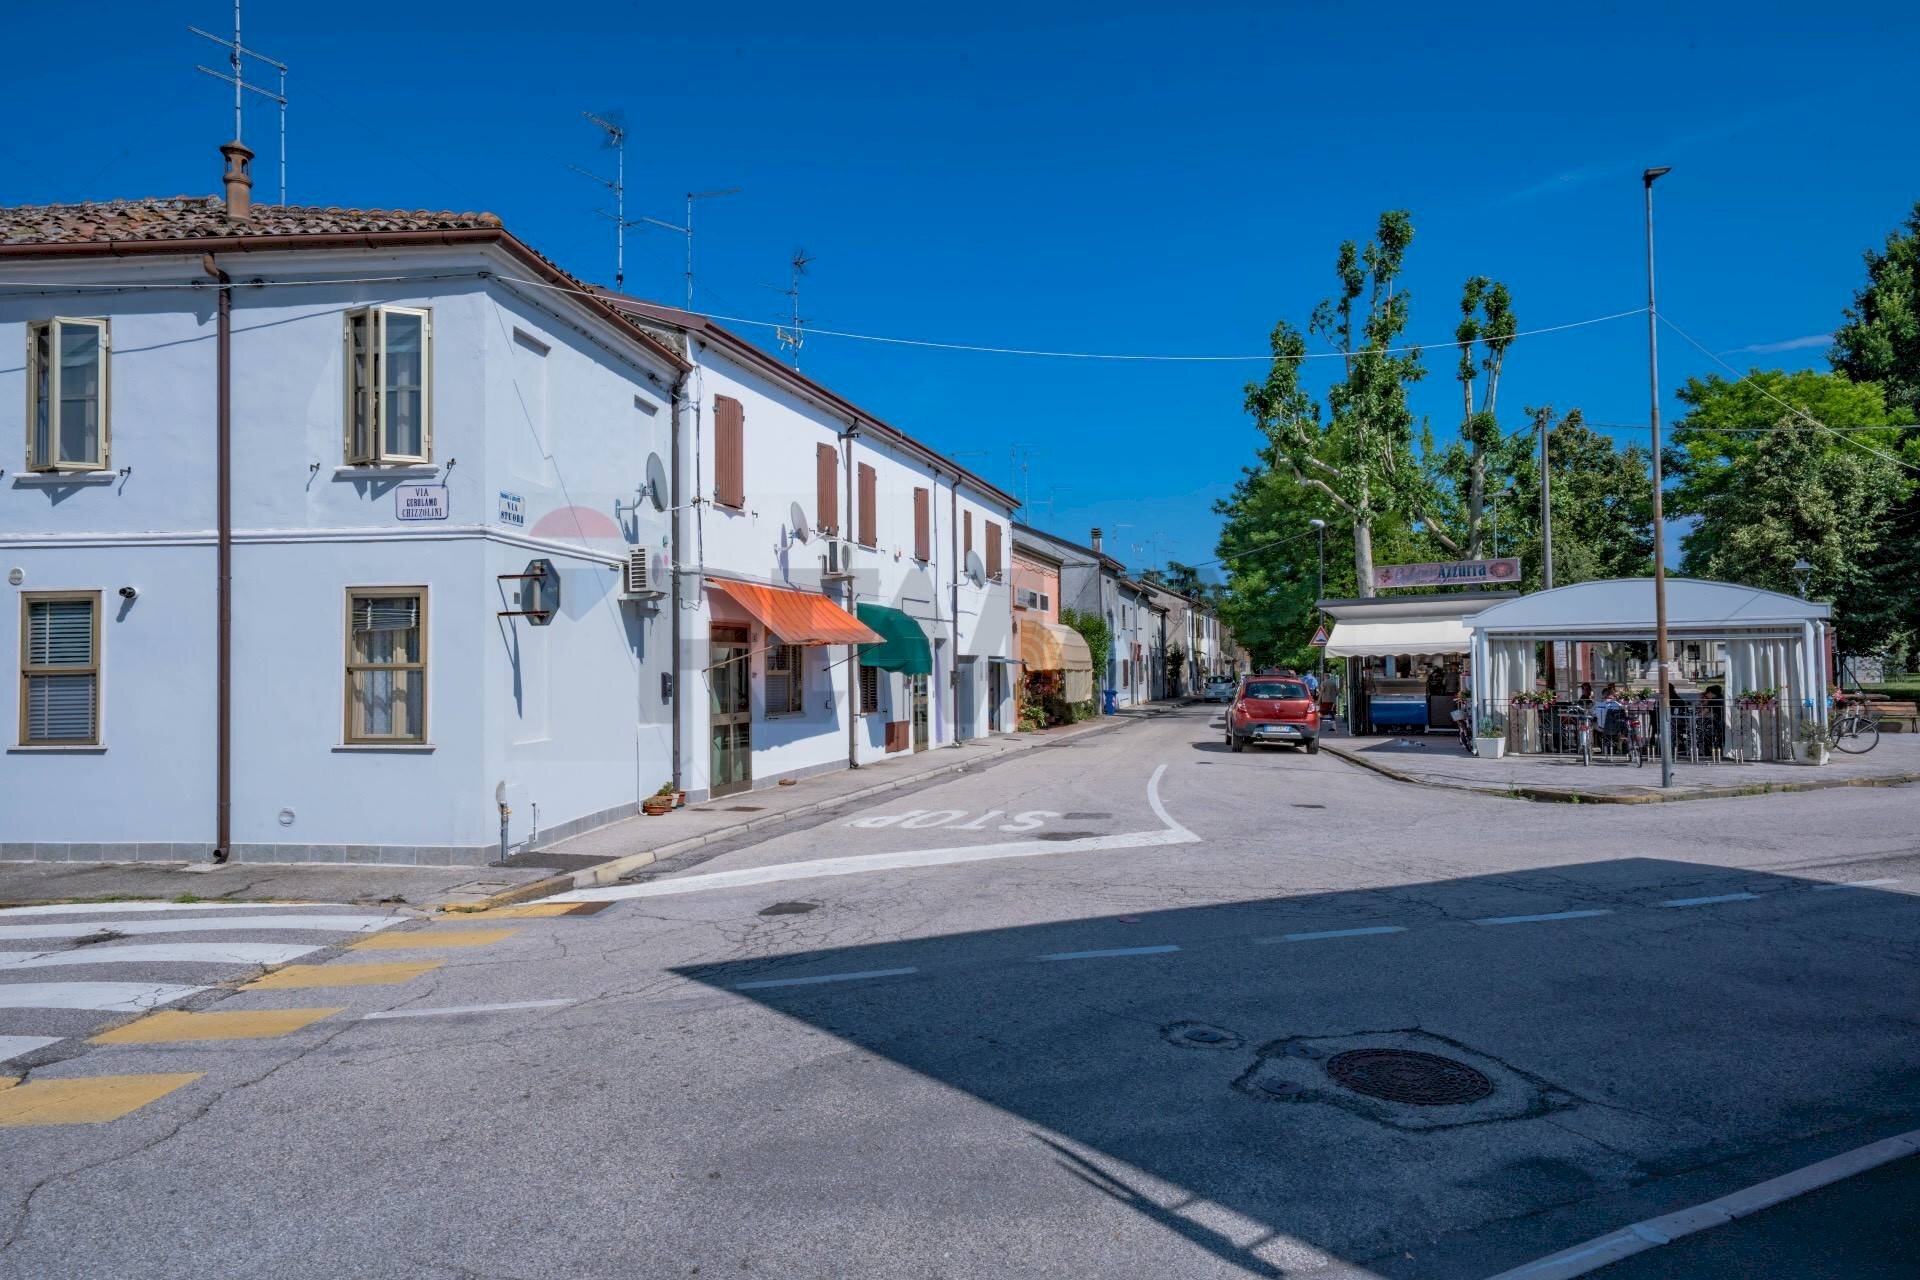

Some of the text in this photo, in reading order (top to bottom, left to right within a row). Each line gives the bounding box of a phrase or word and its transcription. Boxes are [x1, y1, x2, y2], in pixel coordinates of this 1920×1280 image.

[415, 487, 429, 496] VIA
[507, 501, 518, 511] VIA
[402, 507, 442, 517] CHIZZOLINI
[1439, 564, 1487, 578] Azzurra
[849, 810, 1060, 831] STOP
